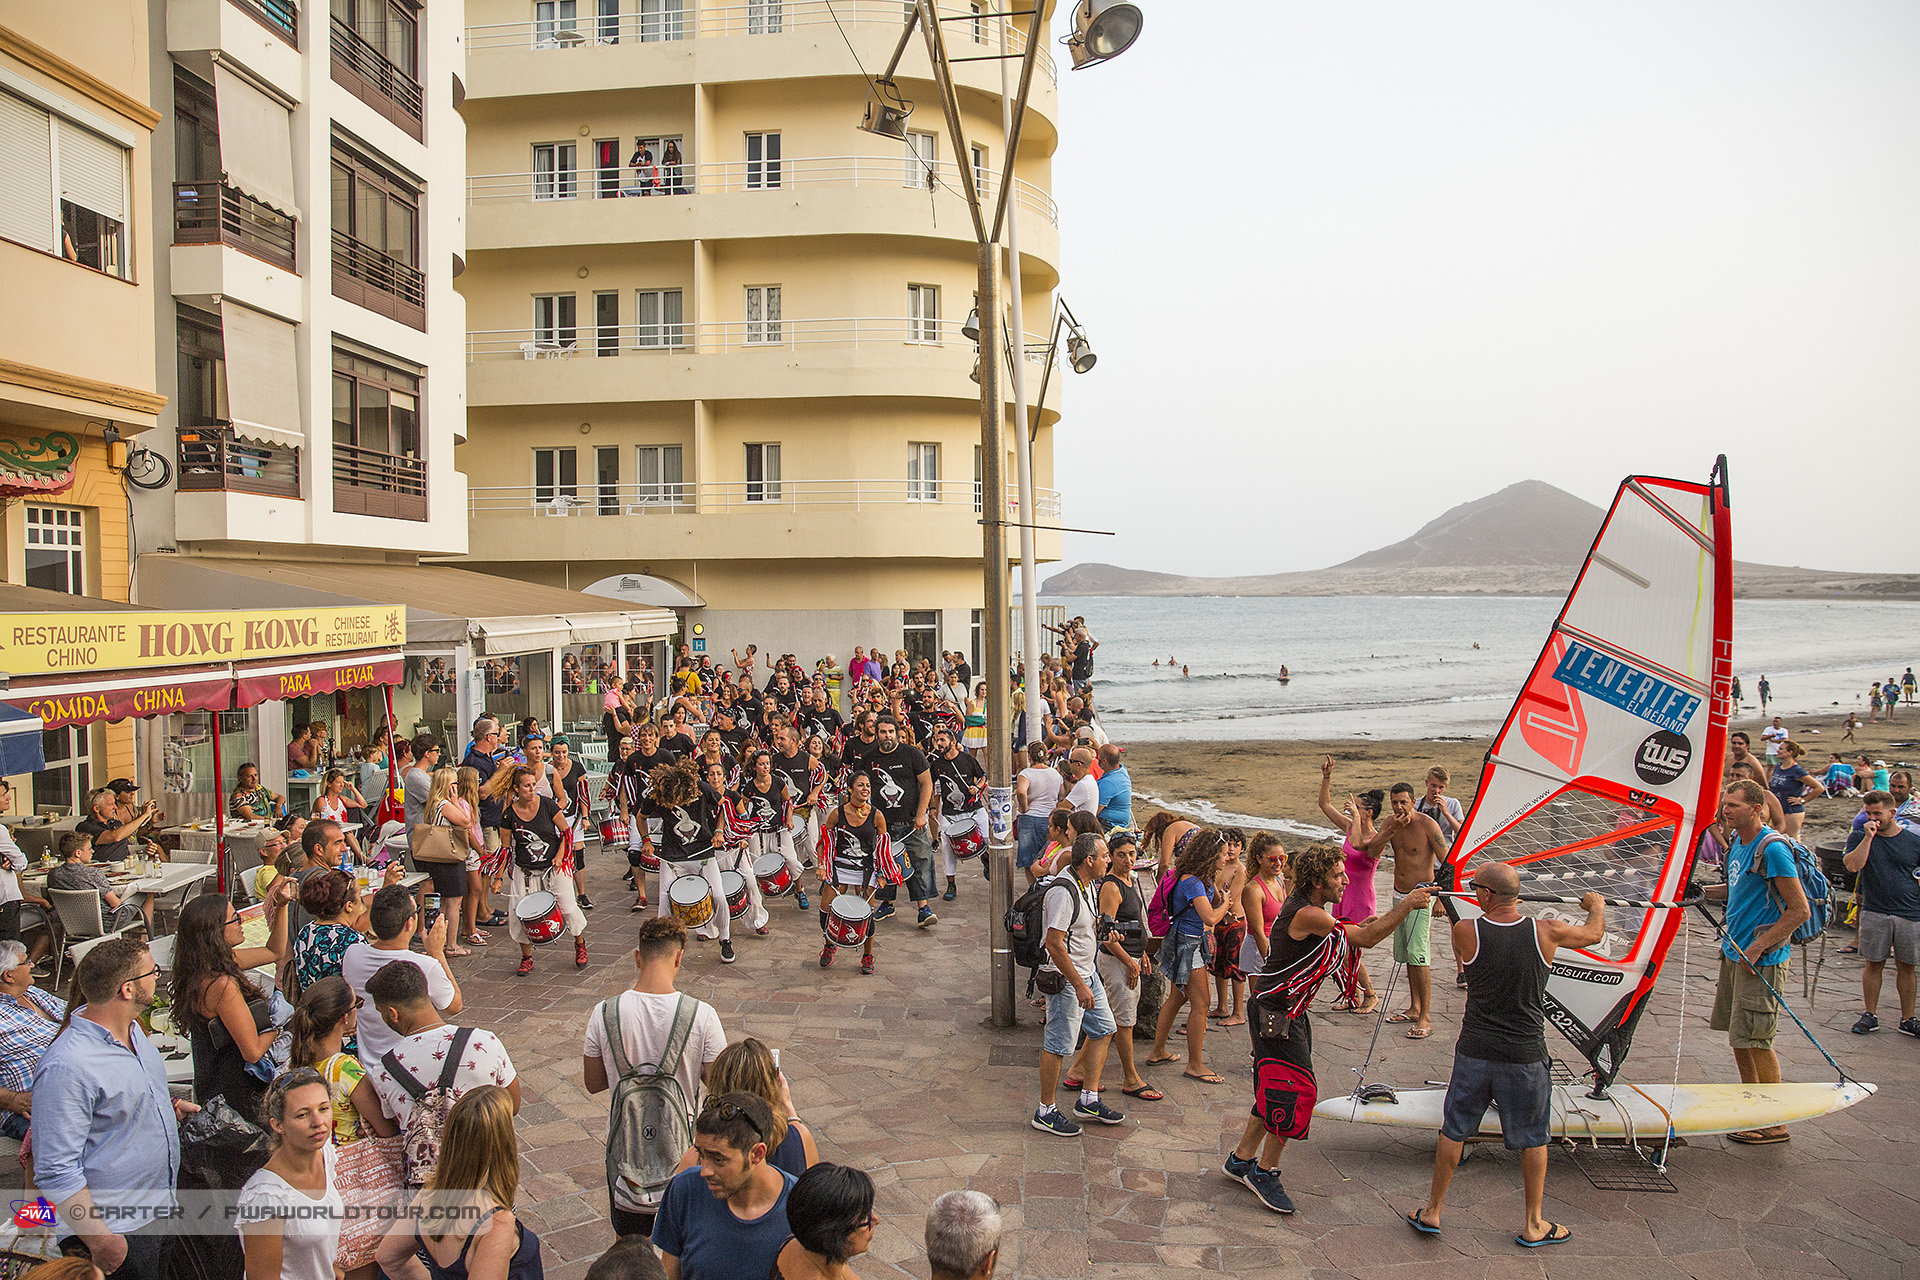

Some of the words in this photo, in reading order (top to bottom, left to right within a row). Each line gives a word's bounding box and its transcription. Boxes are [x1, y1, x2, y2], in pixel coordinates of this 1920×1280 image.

[13, 624, 126, 646] RESTAURANTE
[138, 620, 234, 658] HONG
[243, 616, 320, 651] KONG
[333, 615, 371, 631] CHINESE
[325, 630, 379, 648] RESTAURANT
[695, 641, 703, 650] H
[47, 647, 98, 667] CHINO
[280, 673, 312, 694] PARA
[335, 665, 375, 688] LLEVAR
[1565, 644, 1699, 724] TENERIFE
[1710, 638, 1733, 735] FLIGHT
[29, 694, 110, 724] COMIDA
[133, 687, 186, 712] CHINA
[1625, 700, 1638, 713] EL
[1641, 708, 1685, 734] MÉDANO
